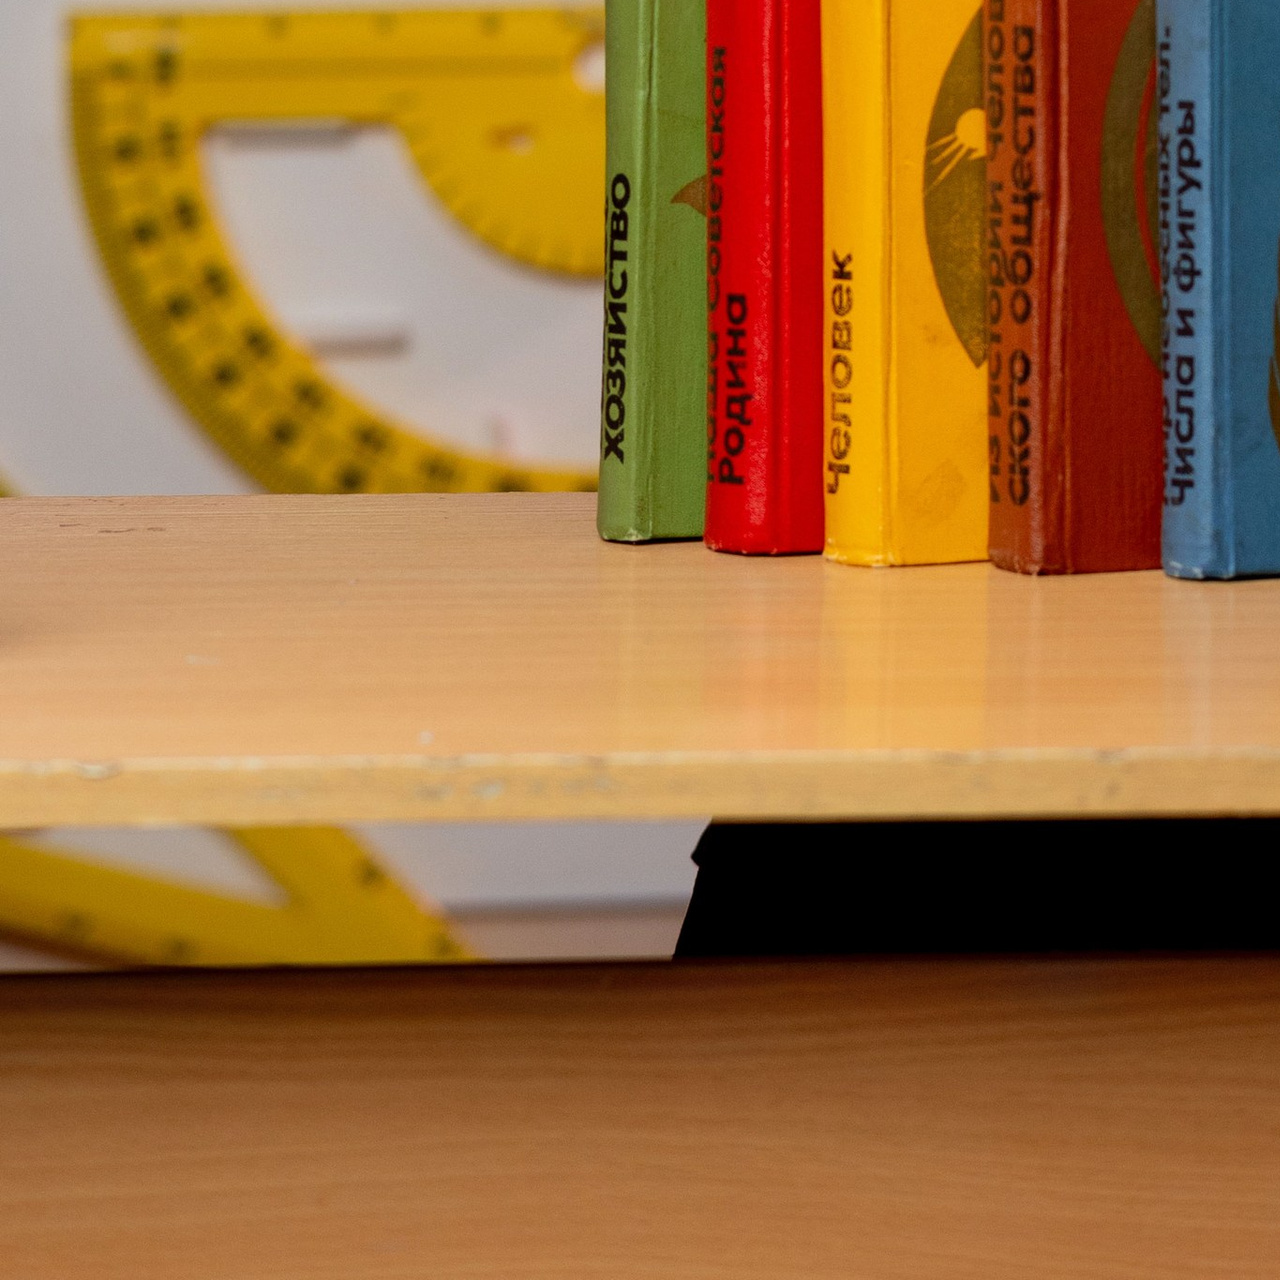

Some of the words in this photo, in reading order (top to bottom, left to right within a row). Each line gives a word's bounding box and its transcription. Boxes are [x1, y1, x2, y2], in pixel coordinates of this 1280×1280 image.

[1003, 25, 1040, 323] общества
[1172, 101, 1202, 293] фигуры
[719, 293, 749, 487] Родина
[825, 250, 853, 495] Человек
[1173, 308, 1195, 338] и
[1007, 351, 1031, 505] ского
[1170, 355, 1195, 506] Числа
